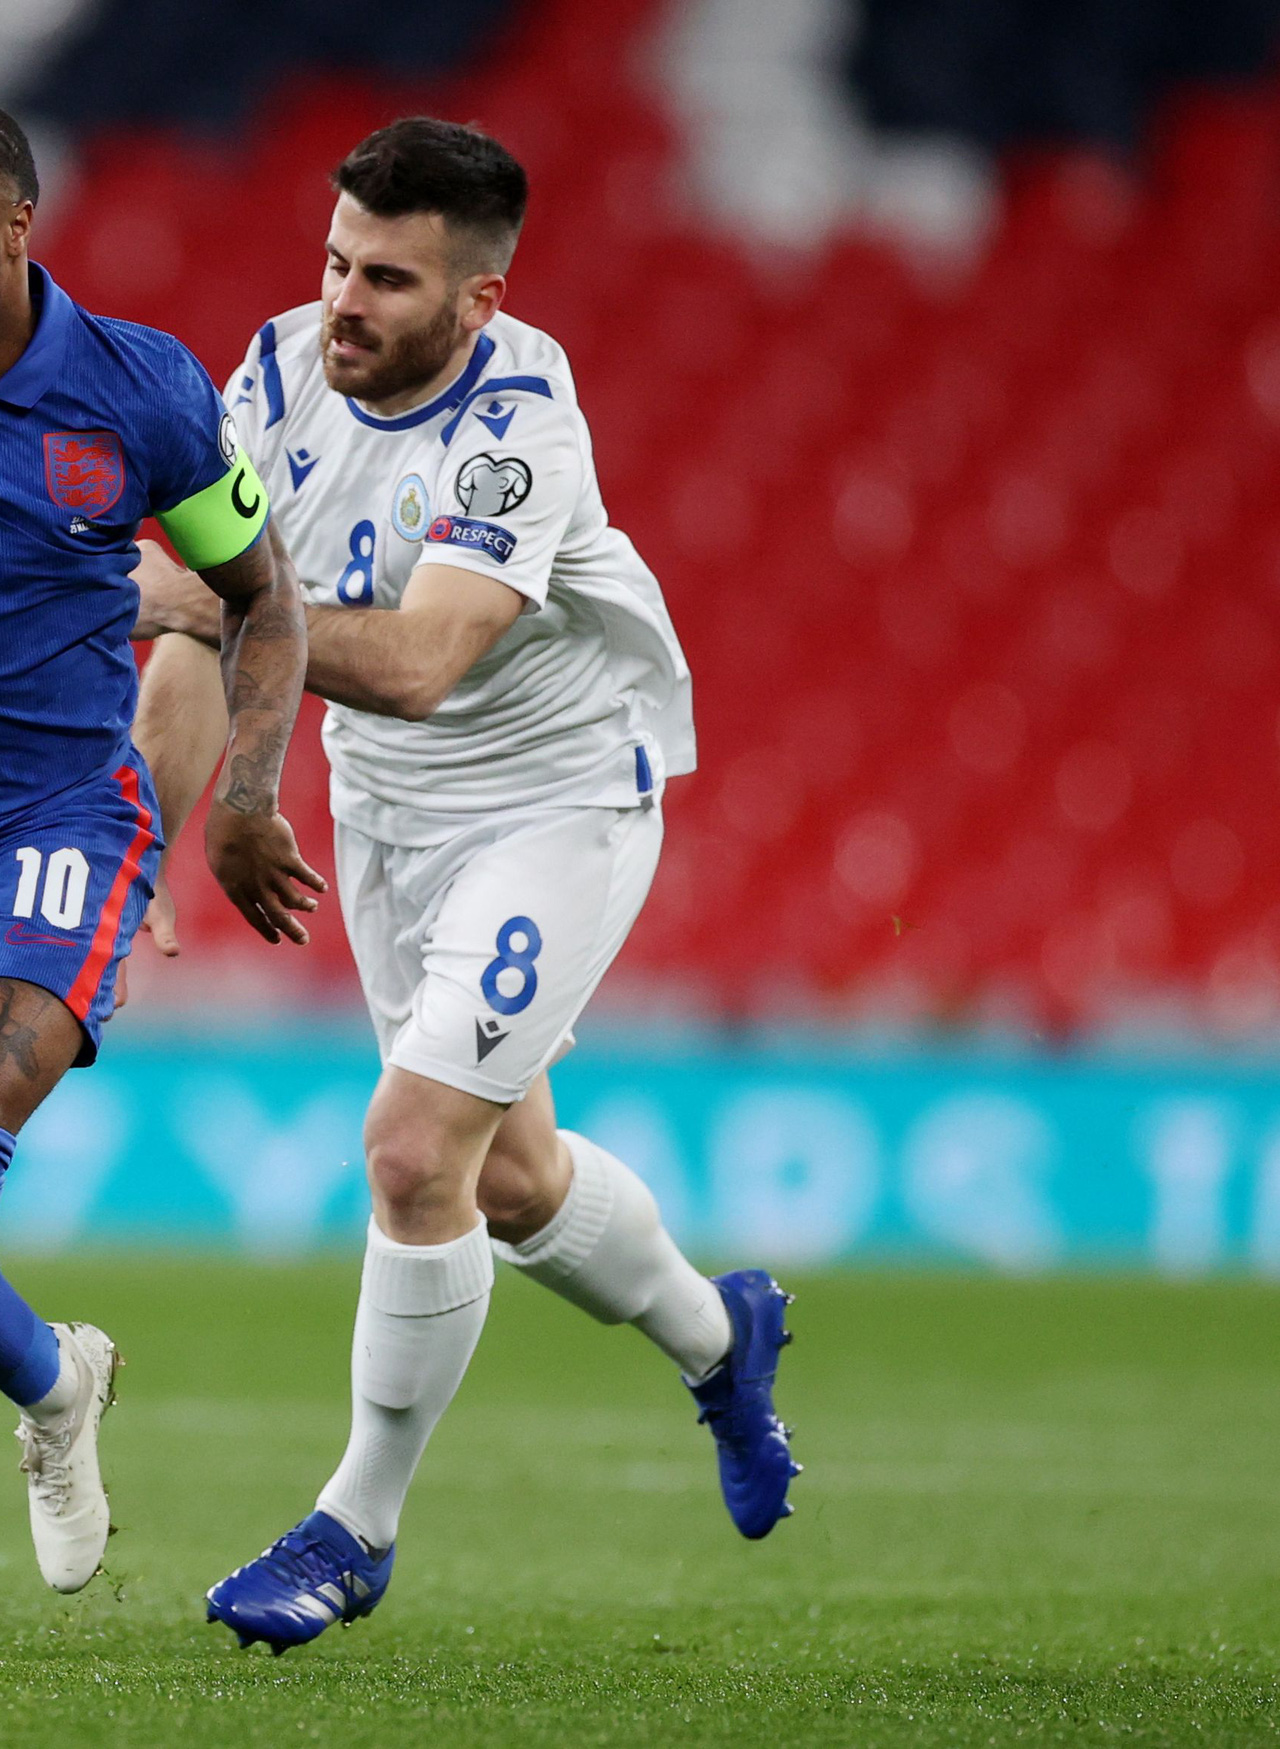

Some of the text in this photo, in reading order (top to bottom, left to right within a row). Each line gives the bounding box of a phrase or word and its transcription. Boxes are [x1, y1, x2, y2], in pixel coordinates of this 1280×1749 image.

[231, 468, 260, 518] C
[337, 519, 376, 607] 8
[451, 525, 513, 555] RESPECT
[12, 847, 90, 930] 10
[481, 915, 542, 1016] 8
